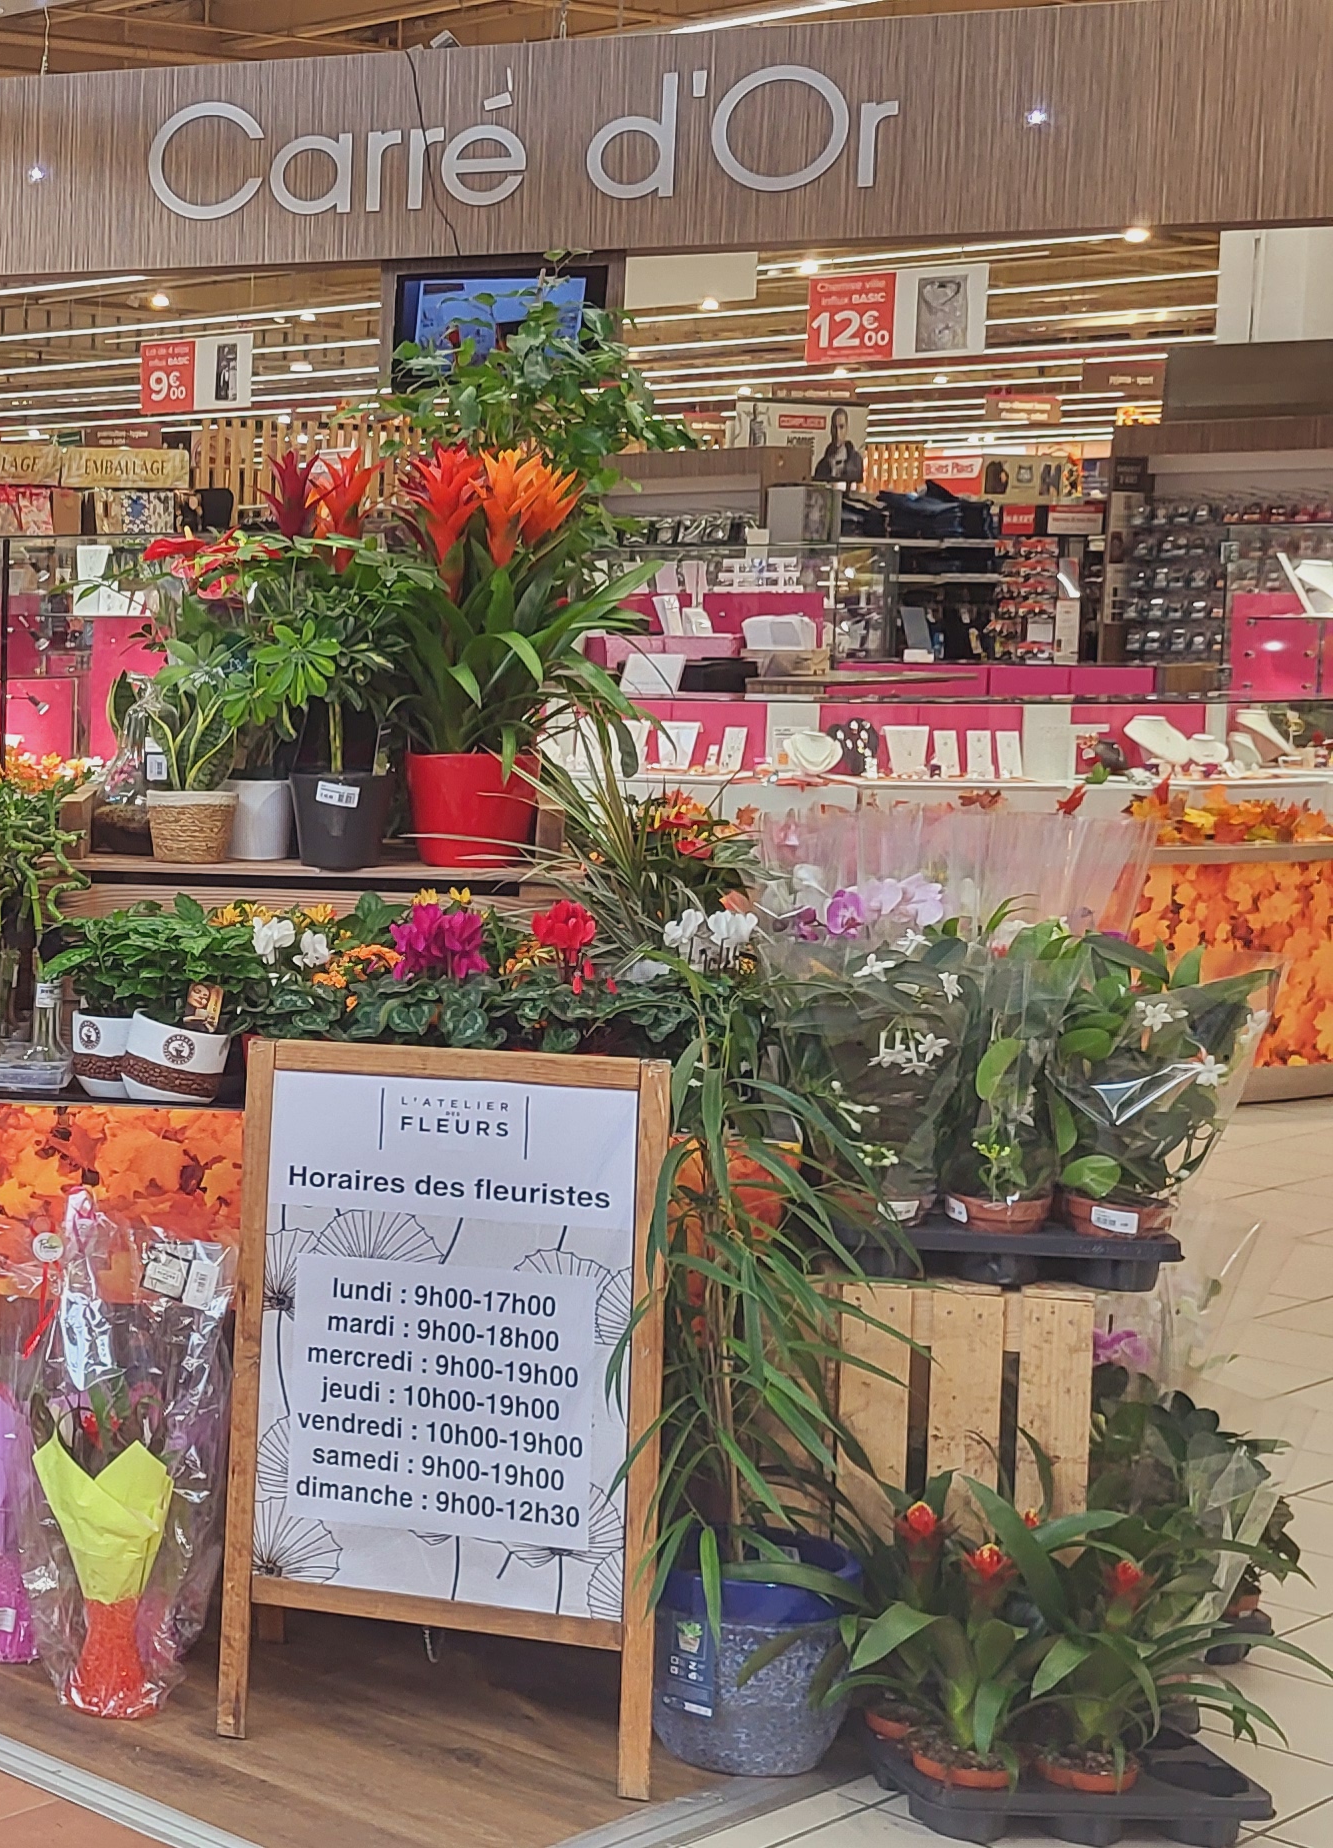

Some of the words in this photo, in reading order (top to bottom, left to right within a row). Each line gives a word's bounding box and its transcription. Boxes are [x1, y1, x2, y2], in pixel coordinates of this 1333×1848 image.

[148, 67, 527, 221] Carré
[586, 64, 899, 199] d'Or
[84, 458, 167, 476] EMBALLAGE
[401, 1096, 509, 1112] L'ATELIER
[400, 1116, 509, 1137] FLEURS
[288, 1165, 405, 1194] Horaires
[415, 1174, 465, 1197] des
[474, 1178, 611, 1209] fleuristes
[333, 1277, 392, 1303] lundi
[414, 1285, 556, 1317] 9h00-17h00
[327, 1313, 394, 1337] mardi
[417, 1319, 559, 1351] 9h00-18h00
[307, 1346, 412, 1372] mercredi
[435, 1354, 578, 1388] 9h00-19h00
[321, 1376, 380, 1403] jeudi
[403, 1385, 560, 1421] 10h00-19h00
[297, 1411, 402, 1439] vendredi
[426, 1421, 583, 1458] 10h00-19h00
[312, 1447, 398, 1473] samedi
[421, 1454, 564, 1491] 9h00-19h00
[296, 1475, 413, 1508] dimanche
[435, 1490, 579, 1528] 9h00-12h30
